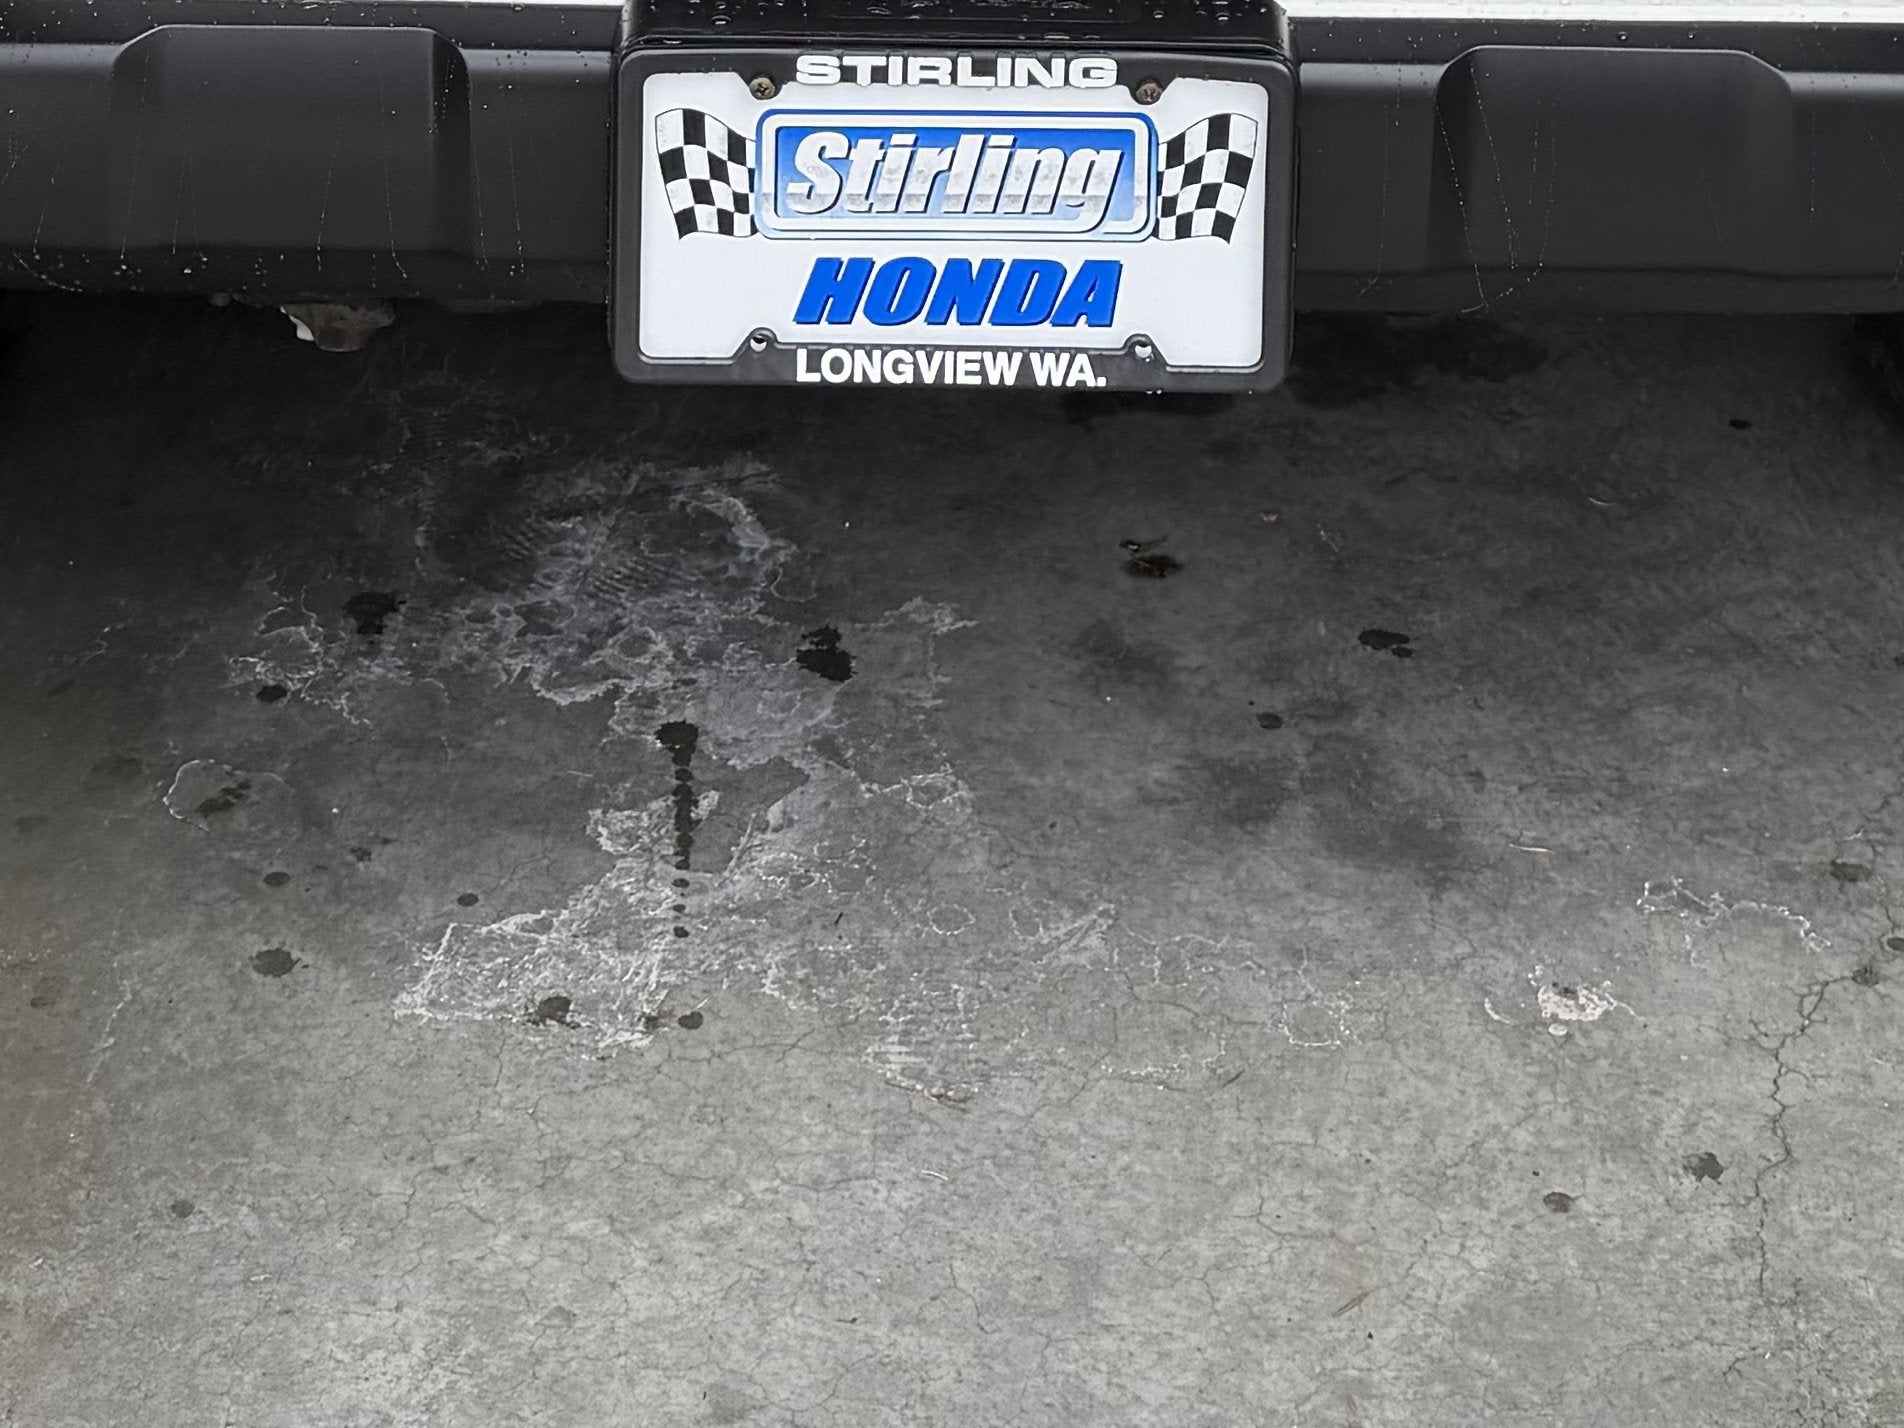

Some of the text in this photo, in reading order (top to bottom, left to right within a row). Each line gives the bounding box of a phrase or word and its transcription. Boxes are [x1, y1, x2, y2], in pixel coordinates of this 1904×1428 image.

[795, 54, 1119, 89] STIRLING
[785, 130, 1125, 232] Stirling
[792, 256, 1123, 328] HONDA
[796, 347, 1108, 387] LONGVIEW WA.
